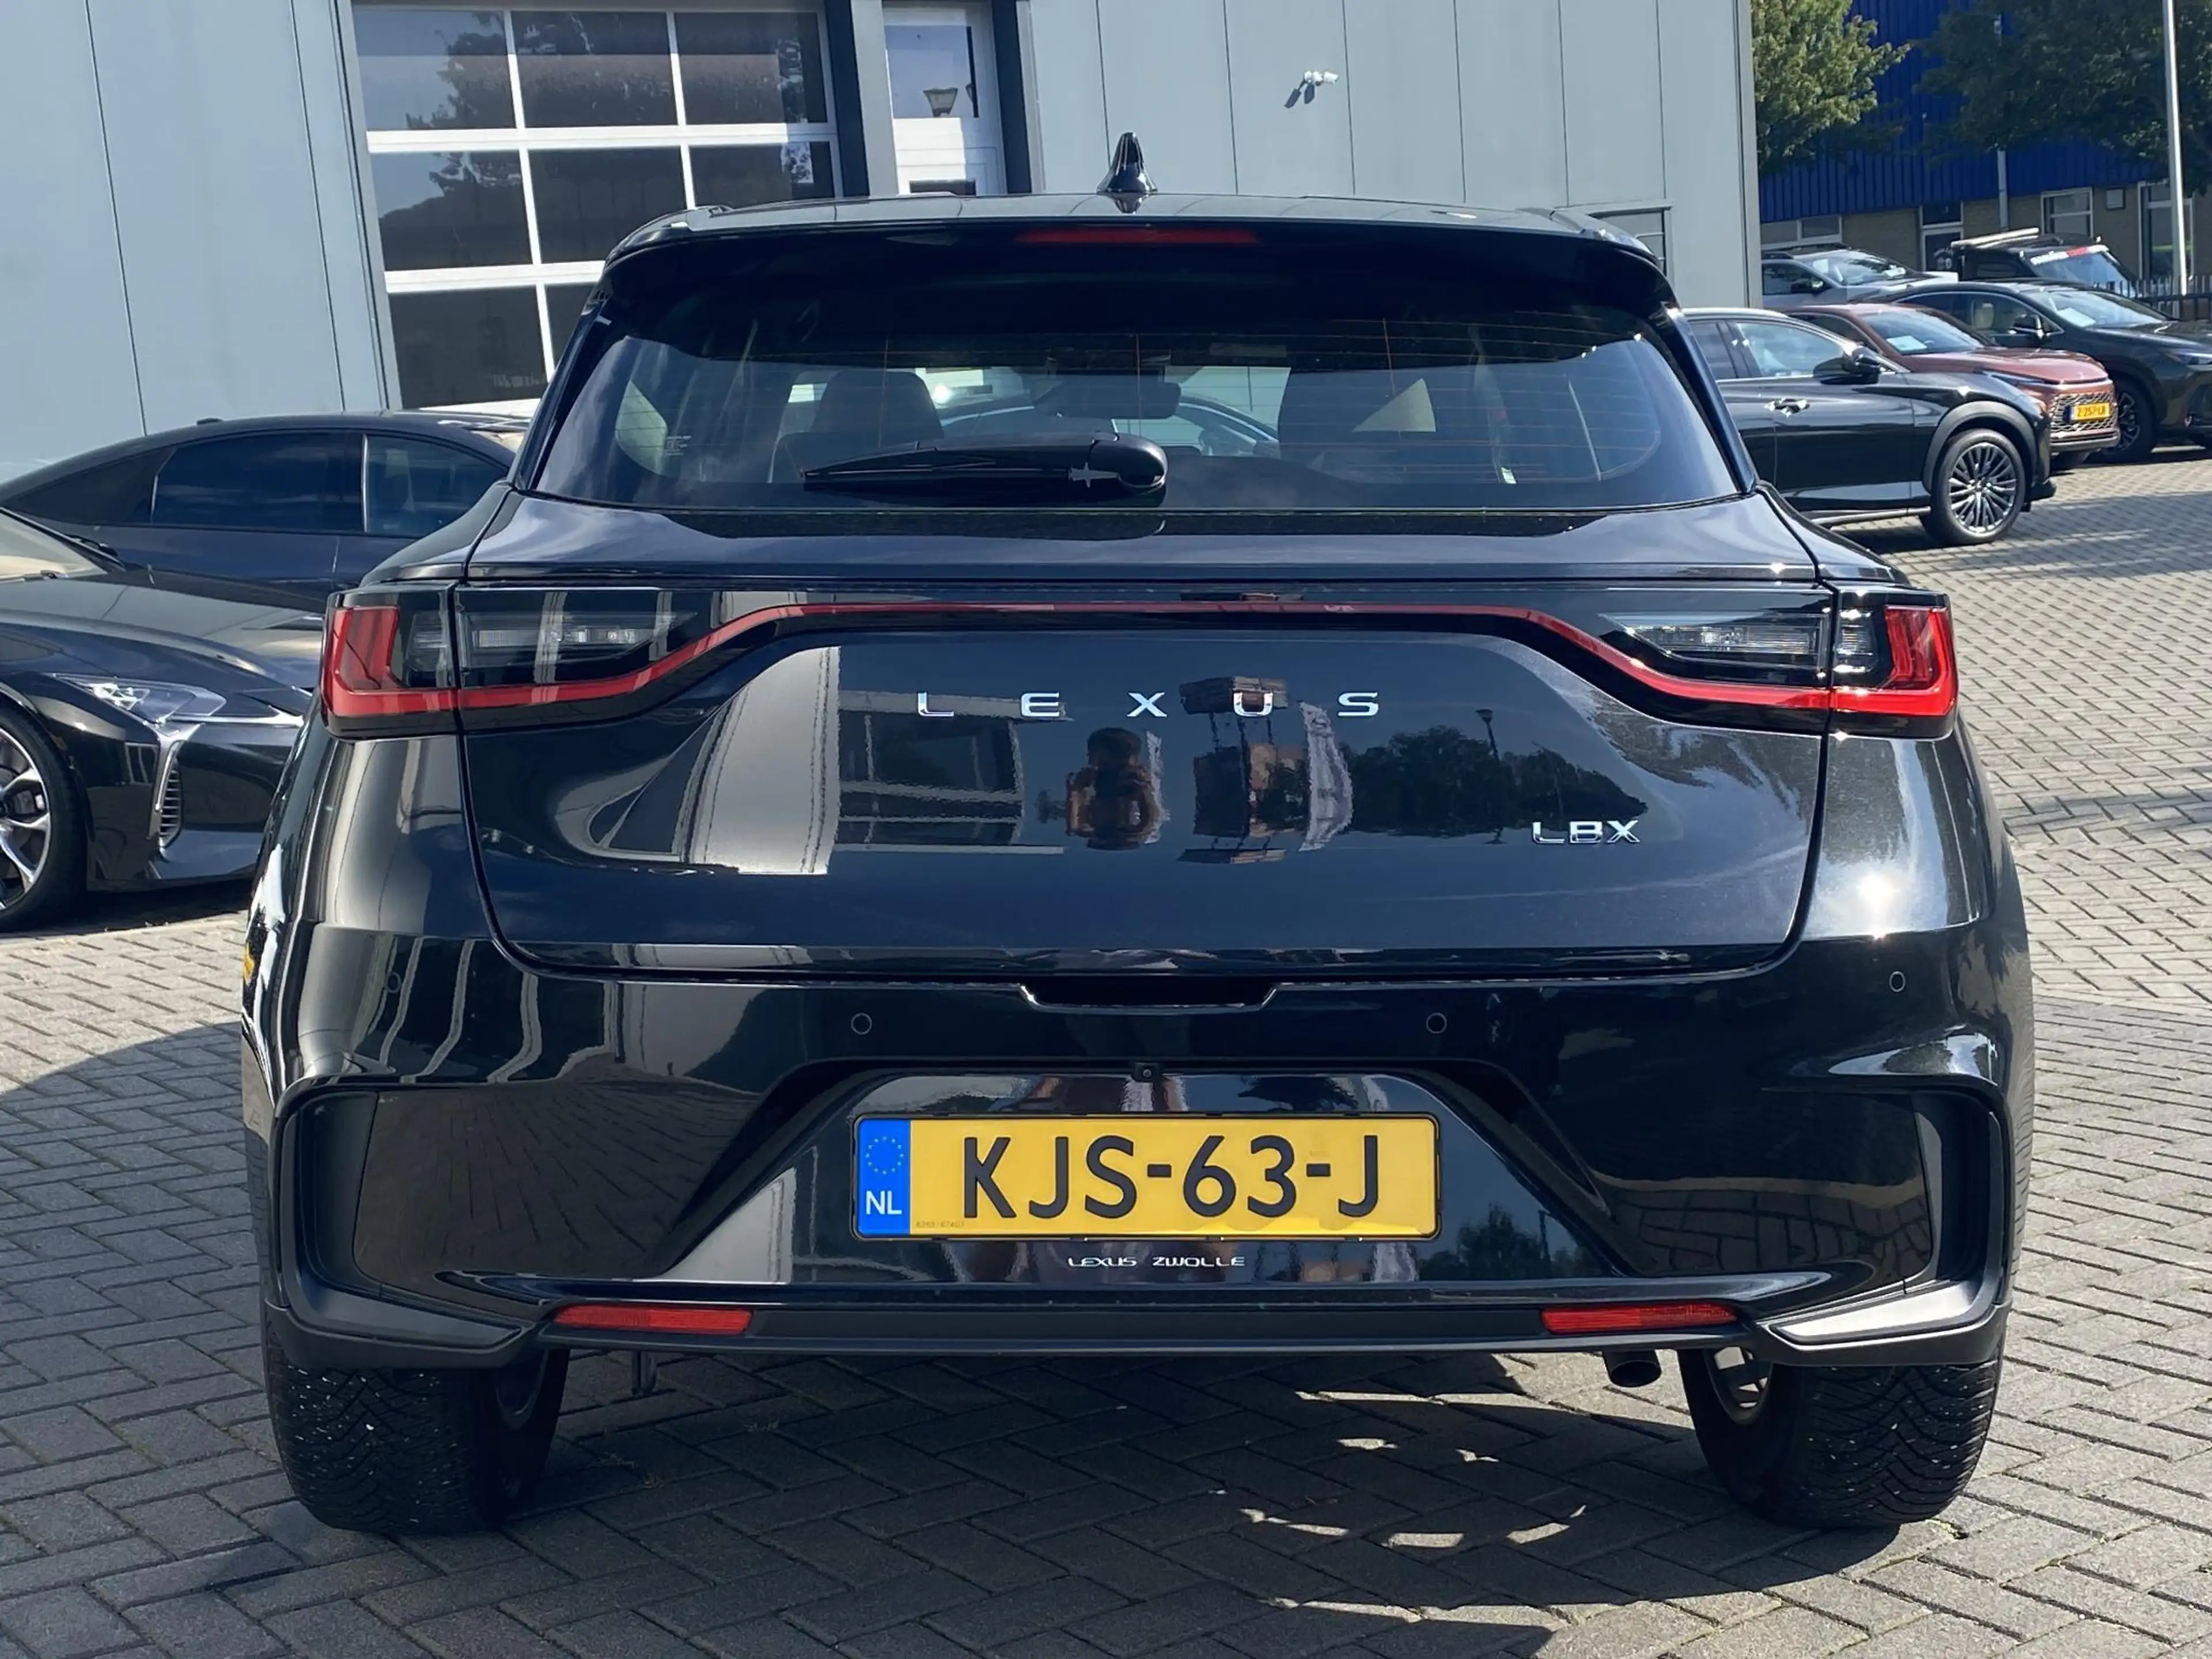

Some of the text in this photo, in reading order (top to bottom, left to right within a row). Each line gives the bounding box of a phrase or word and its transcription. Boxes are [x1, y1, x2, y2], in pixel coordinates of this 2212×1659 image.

[917, 691, 1380, 717] LEXUS
[1532, 819, 1641, 844] LBX
[963, 1134, 1379, 1219] KJS-63-J
[865, 1190, 903, 1215] NL
[1067, 1256, 1245, 1267] LEXUS ZWOLLE
